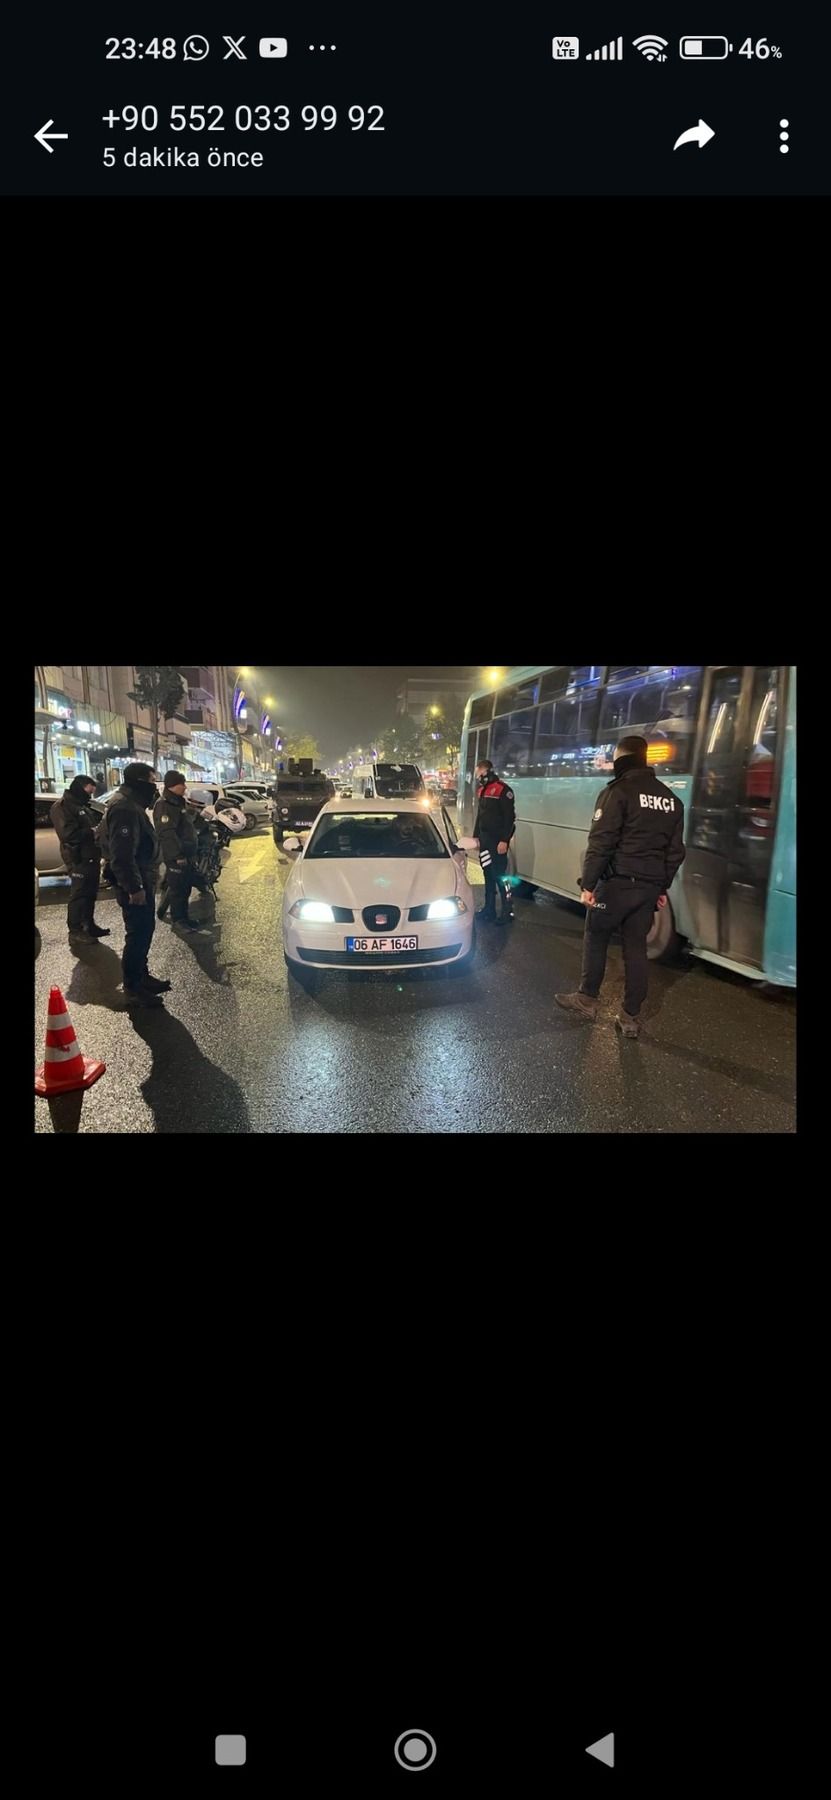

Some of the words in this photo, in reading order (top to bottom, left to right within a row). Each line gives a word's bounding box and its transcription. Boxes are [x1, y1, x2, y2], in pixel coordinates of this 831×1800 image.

[354, 939, 368, 951] 06
[371, 939, 388, 951] AF
[390, 938, 416, 950] 1646
